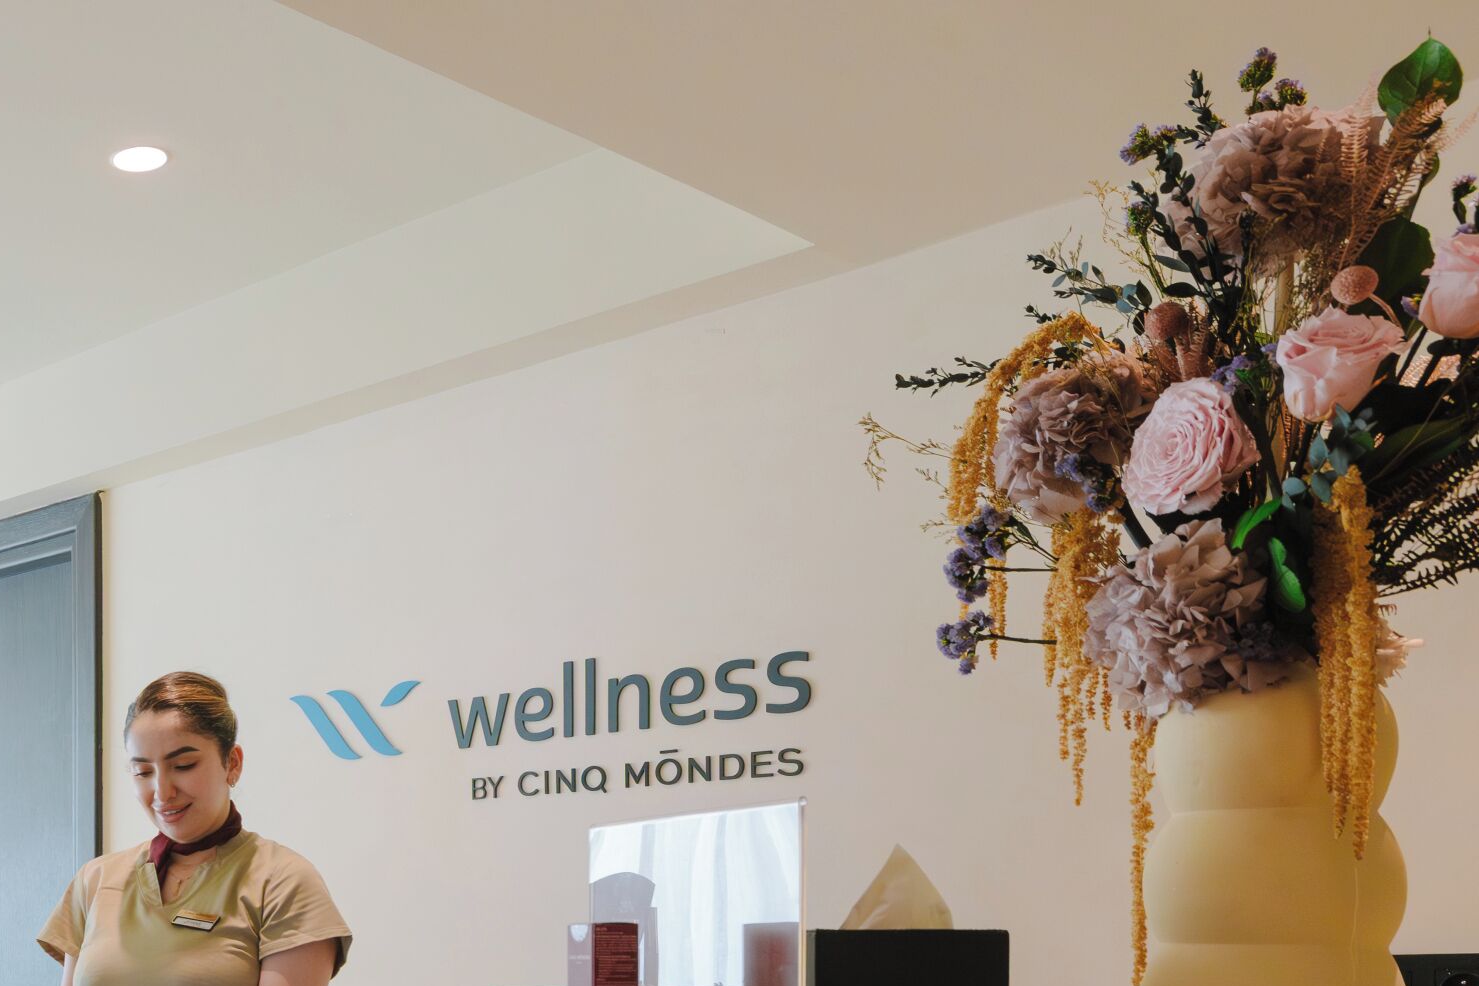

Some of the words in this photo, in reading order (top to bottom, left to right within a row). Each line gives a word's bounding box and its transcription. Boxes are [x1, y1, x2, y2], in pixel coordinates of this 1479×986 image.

[448, 651, 811, 749] wellness
[471, 775, 504, 801] BY
[518, 766, 608, 797] CINQ
